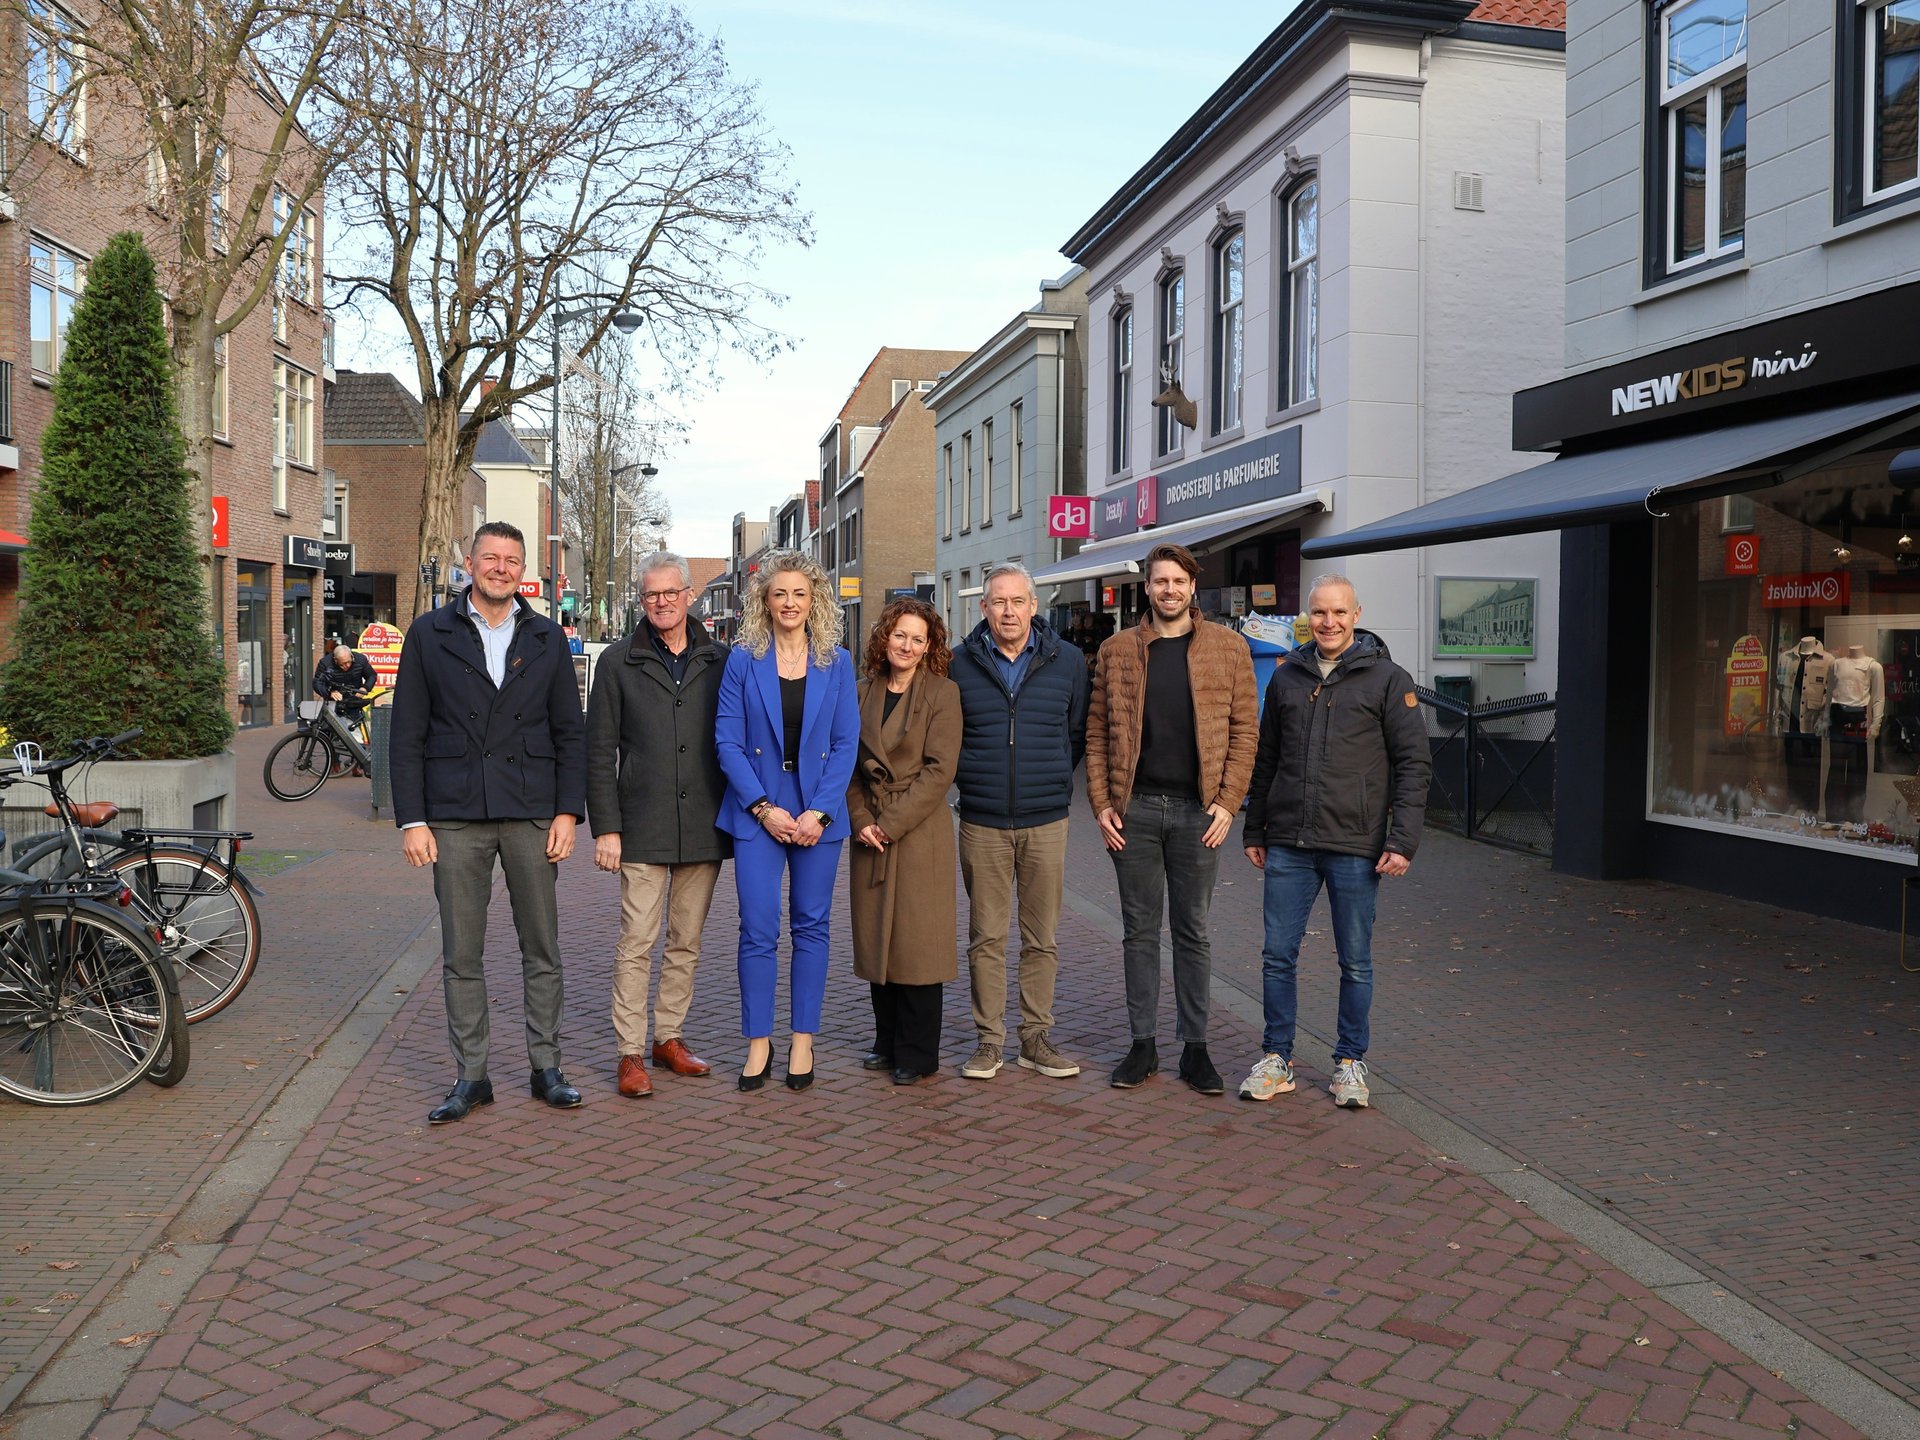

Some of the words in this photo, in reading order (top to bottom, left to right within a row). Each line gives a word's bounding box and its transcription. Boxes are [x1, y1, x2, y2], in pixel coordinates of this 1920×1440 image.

[1751, 342, 1818, 379] mini
[1166, 477, 1213, 505] DROGISTERIJ
[1215, 472, 1221, 489] &
[1223, 453, 1280, 489] PARFUMERIE
[1051, 502, 1086, 532] da
[1138, 486, 1149, 519] da
[369, 654, 400, 663] Kruidva
